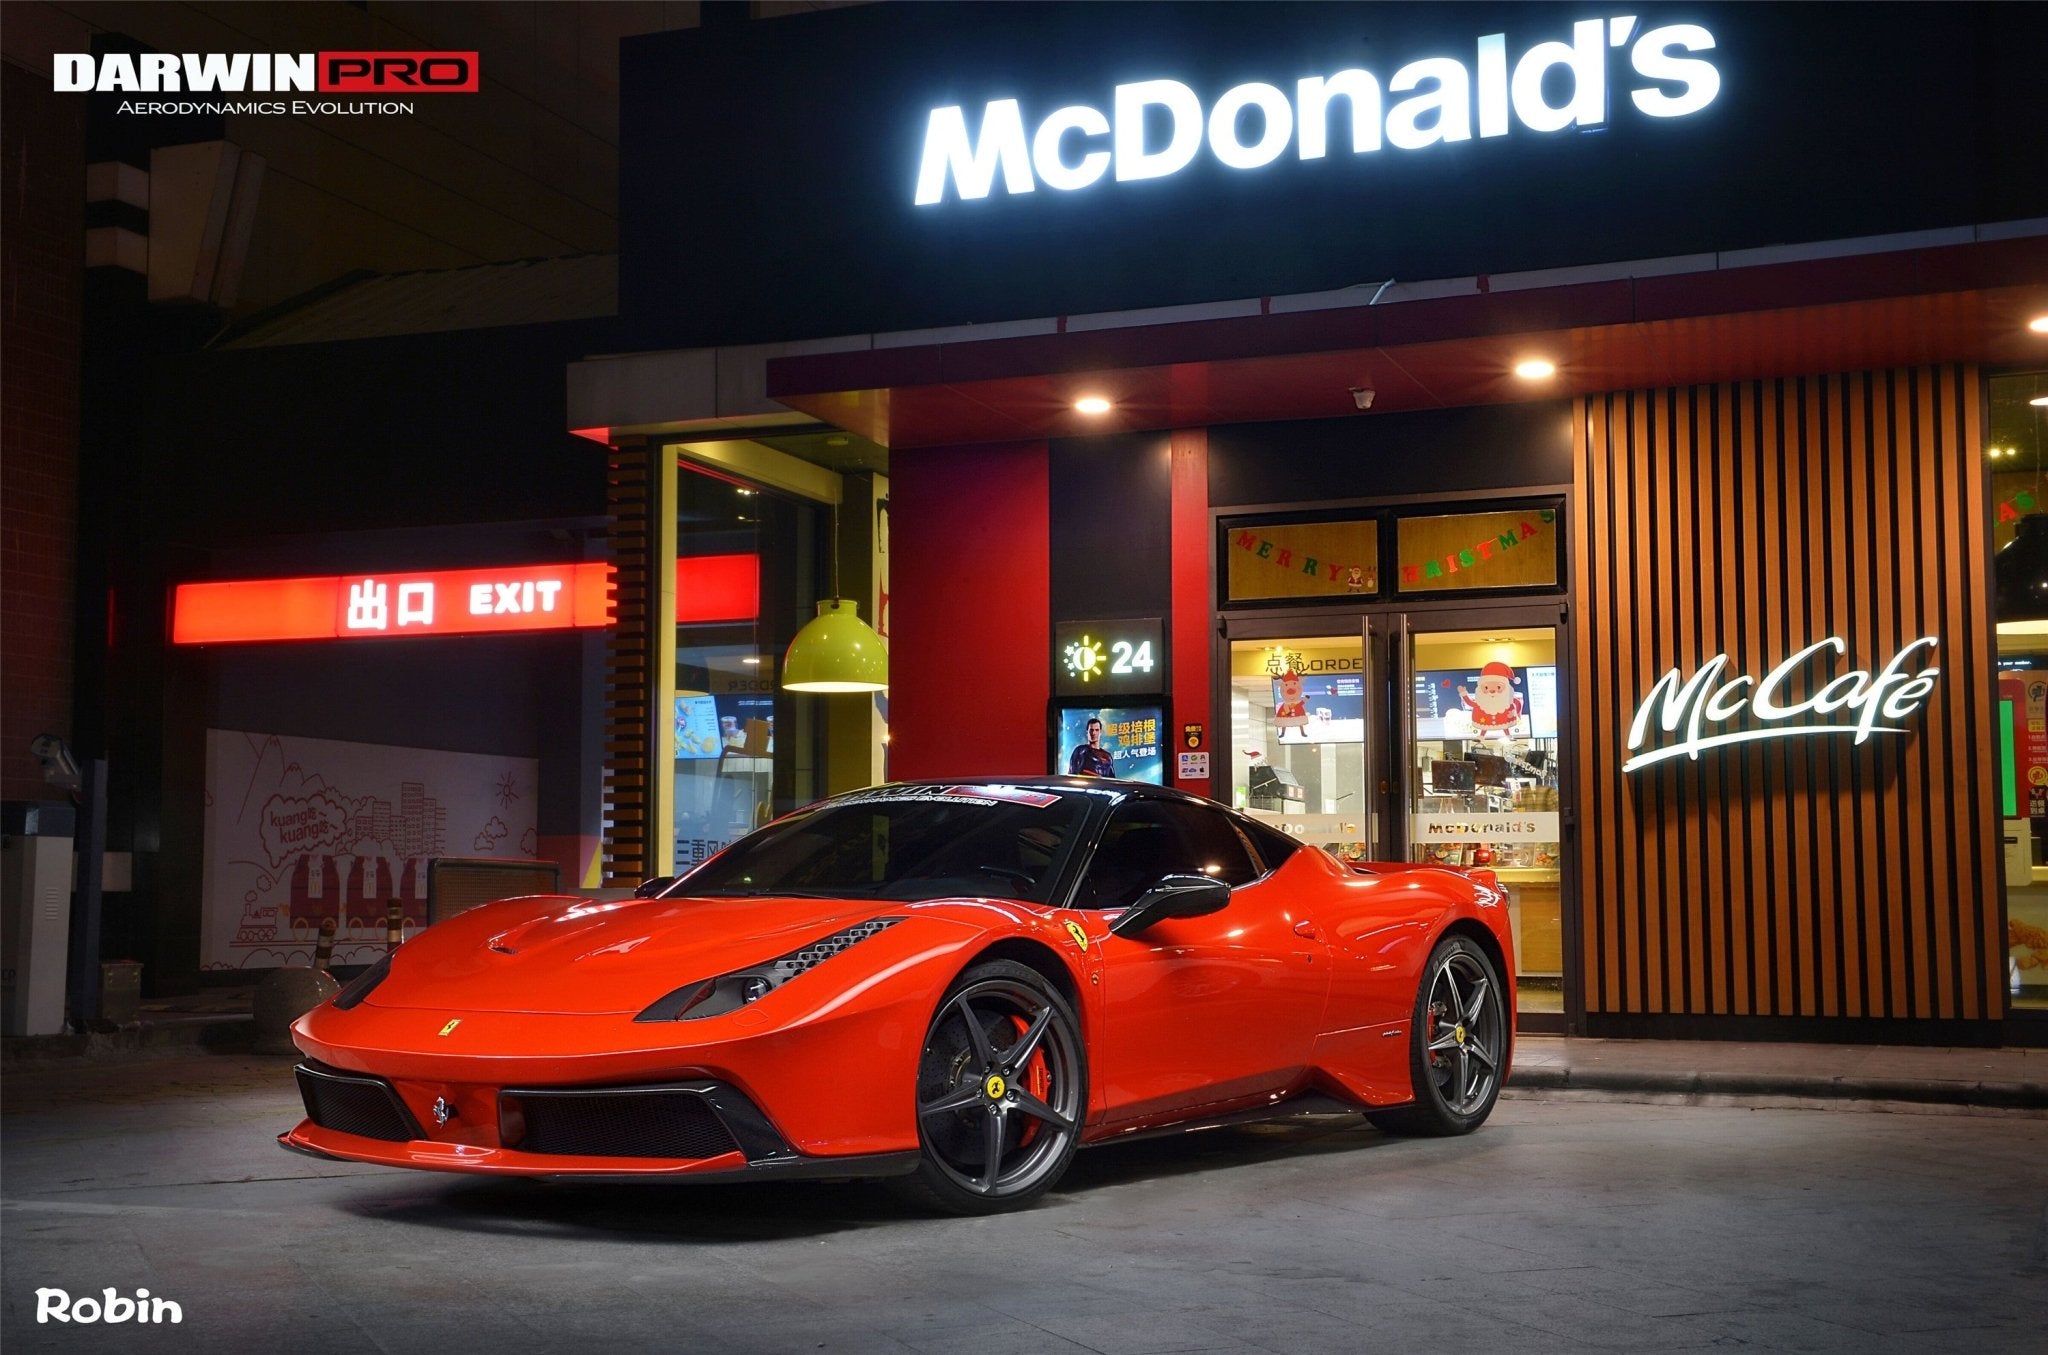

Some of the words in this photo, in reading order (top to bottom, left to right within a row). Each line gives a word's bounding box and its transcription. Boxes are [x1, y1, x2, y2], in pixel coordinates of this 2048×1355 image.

[914, 14, 1721, 206] McDonald's
[1236, 529, 1344, 582] MERRY
[1402, 510, 1555, 583] HRISTMAS
[348, 579, 434, 630] 出口
[469, 580, 562, 615] EXIT
[1111, 640, 1154, 674] 24
[1310, 658, 1363, 671] ORDE
[1626, 636, 1940, 761] McCafé
[1113, 746, 1157, 760] 超人气登场
[1428, 821, 1536, 834] McDonald's
